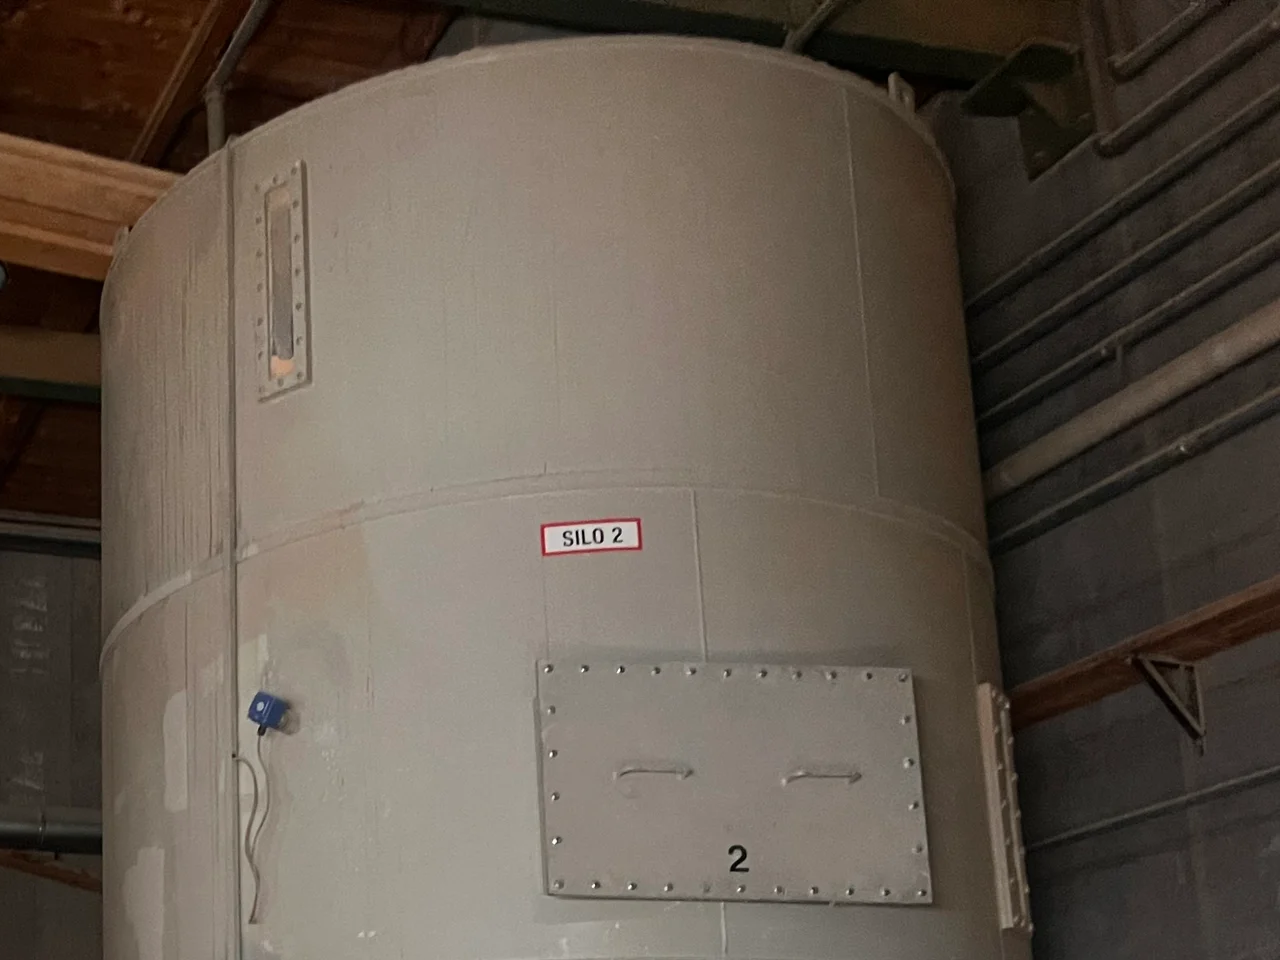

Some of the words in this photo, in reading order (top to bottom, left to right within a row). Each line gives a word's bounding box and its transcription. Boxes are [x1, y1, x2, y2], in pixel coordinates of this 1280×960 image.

[562, 527, 604, 547] SILO
[612, 527, 623, 543] 2
[728, 844, 750, 873] 2
